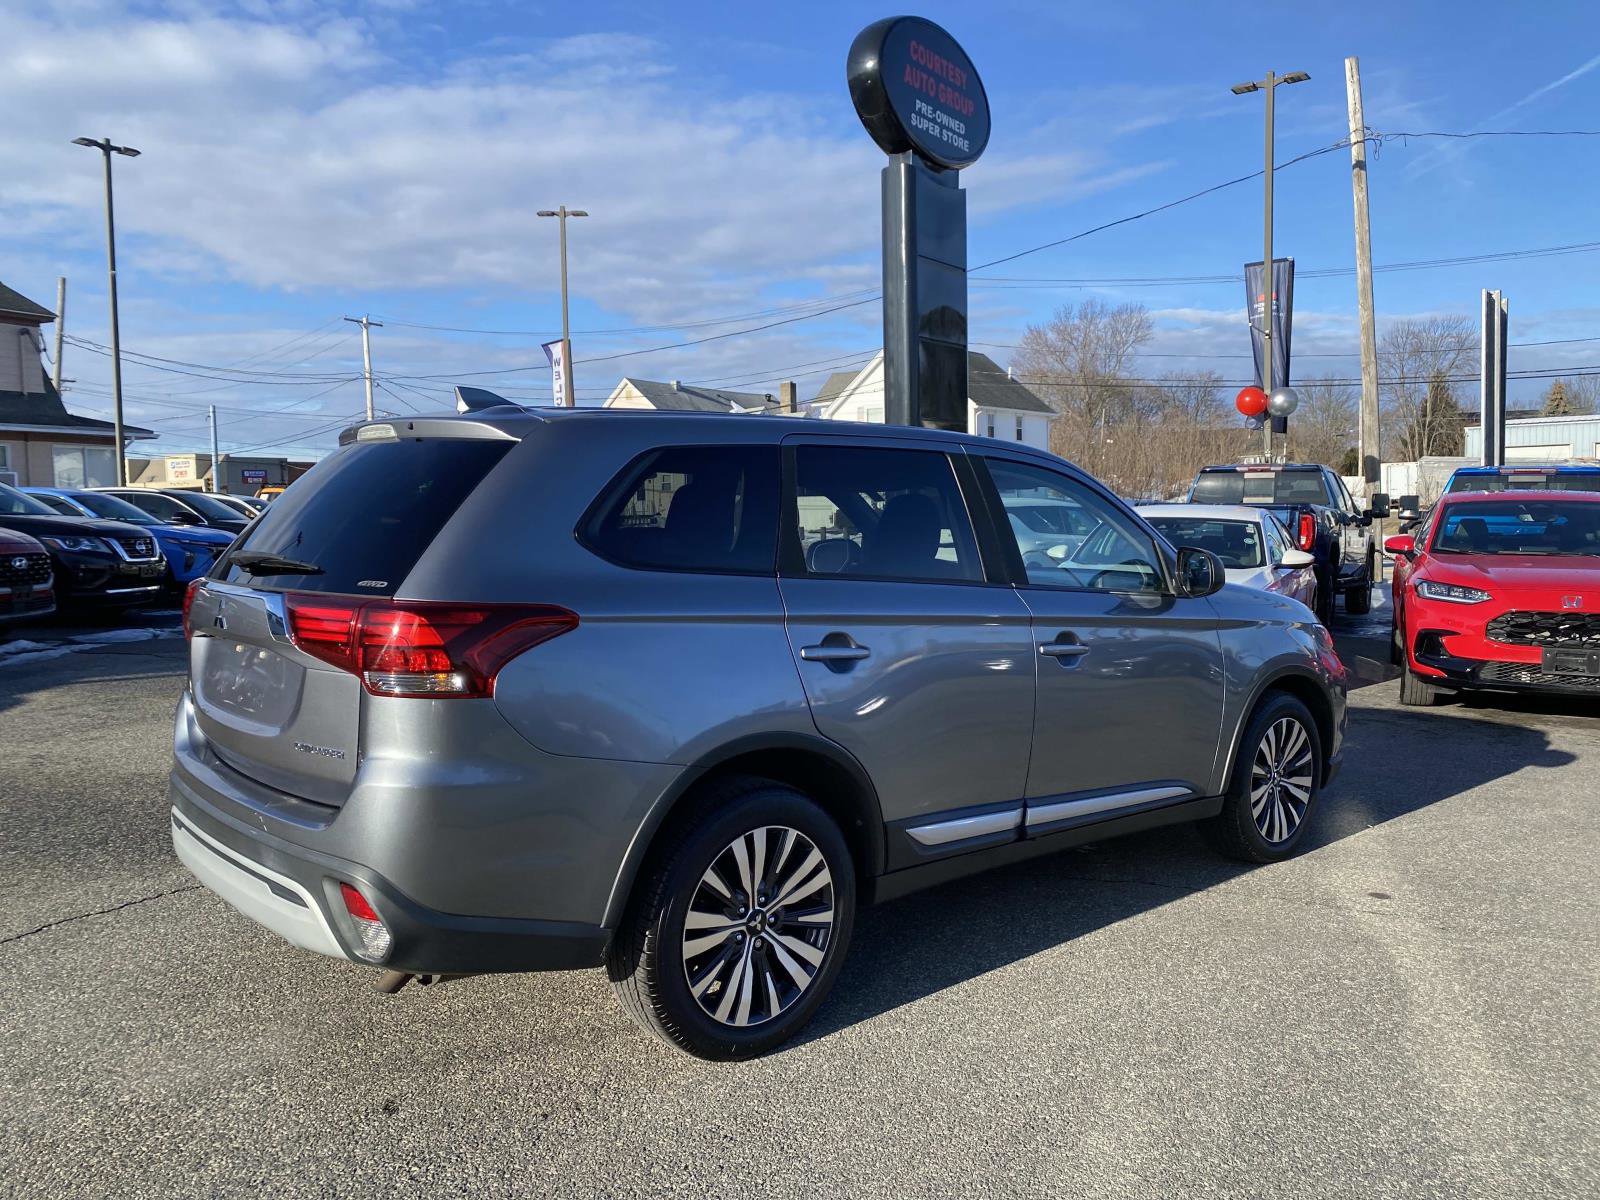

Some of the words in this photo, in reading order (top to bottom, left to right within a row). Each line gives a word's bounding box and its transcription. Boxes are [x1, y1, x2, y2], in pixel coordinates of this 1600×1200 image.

[910, 40, 967, 90] COURTESY
[903, 64, 936, 97] AUTO
[938, 82, 975, 118] GROUP
[910, 112, 940, 138] SUPER
[942, 129, 969, 152] STORE
[915, 99, 966, 135] PRE-OWNED
